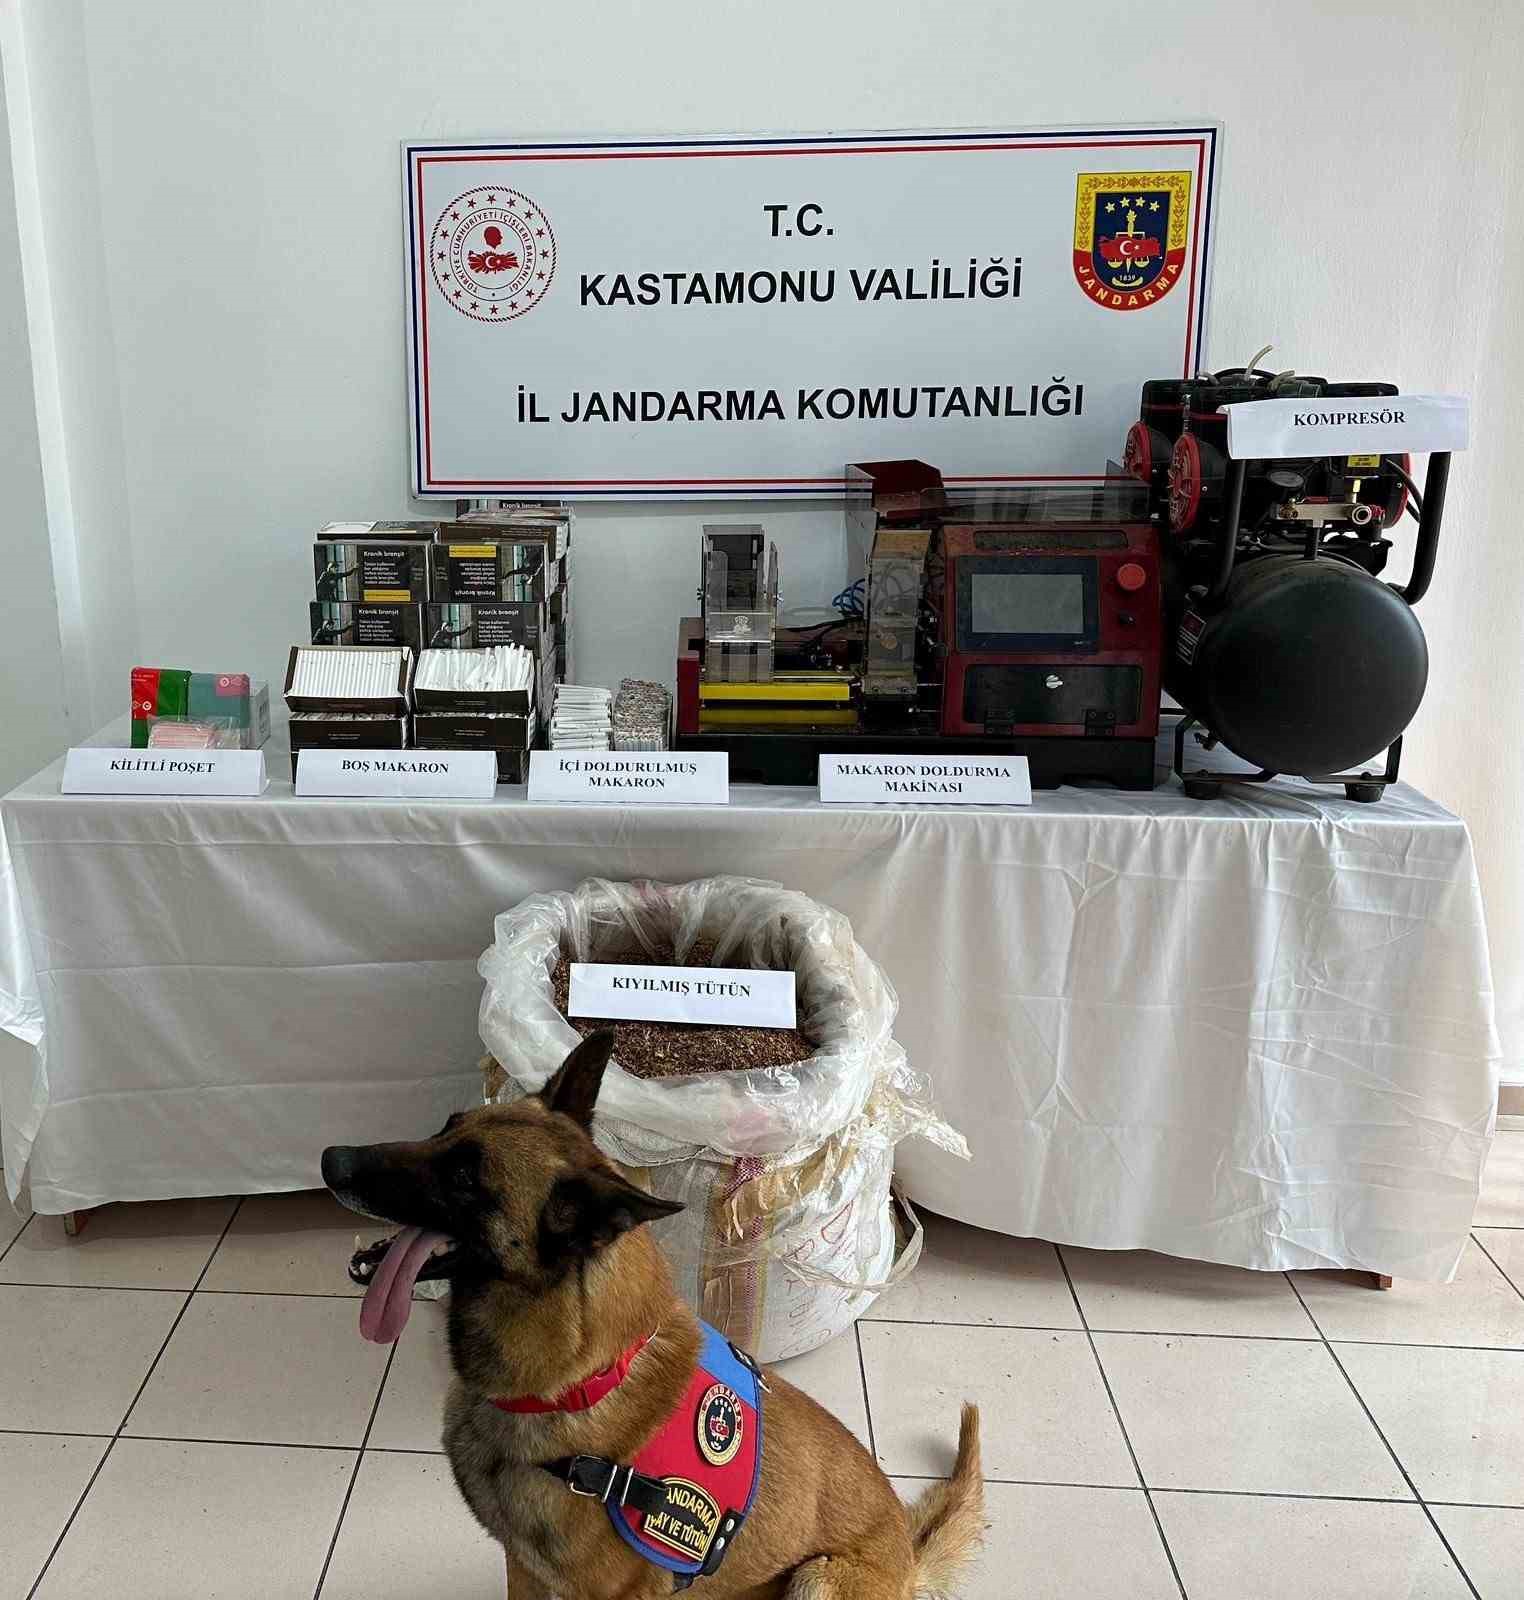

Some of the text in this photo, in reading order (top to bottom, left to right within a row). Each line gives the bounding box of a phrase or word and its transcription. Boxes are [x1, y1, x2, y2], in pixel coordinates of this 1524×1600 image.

[764, 204, 834, 237] T.C.
[581, 257, 1021, 306] KASTAMONU VALİLİĞİ
[1079, 263, 1179, 306] JANDARMA
[519, 376, 1083, 423] İL JANDARMA KOMUTANLIĞI
[1294, 408, 1406, 426] KOMPRESÖR
[109, 758, 216, 774] KİLİTLİ POŞET
[341, 759, 449, 774] BOŞ MAKARON
[559, 759, 697, 775] İÇİ DOLDURULMUŞ
[837, 764, 1011, 778] MAKARON DOLDURMA
[588, 776, 665, 789] MAKARON
[885, 778, 963, 793] MAKİNASI
[612, 976, 750, 997] KIYILMIŞ TÜTÜN
[668, 1517, 682, 1537] VE
